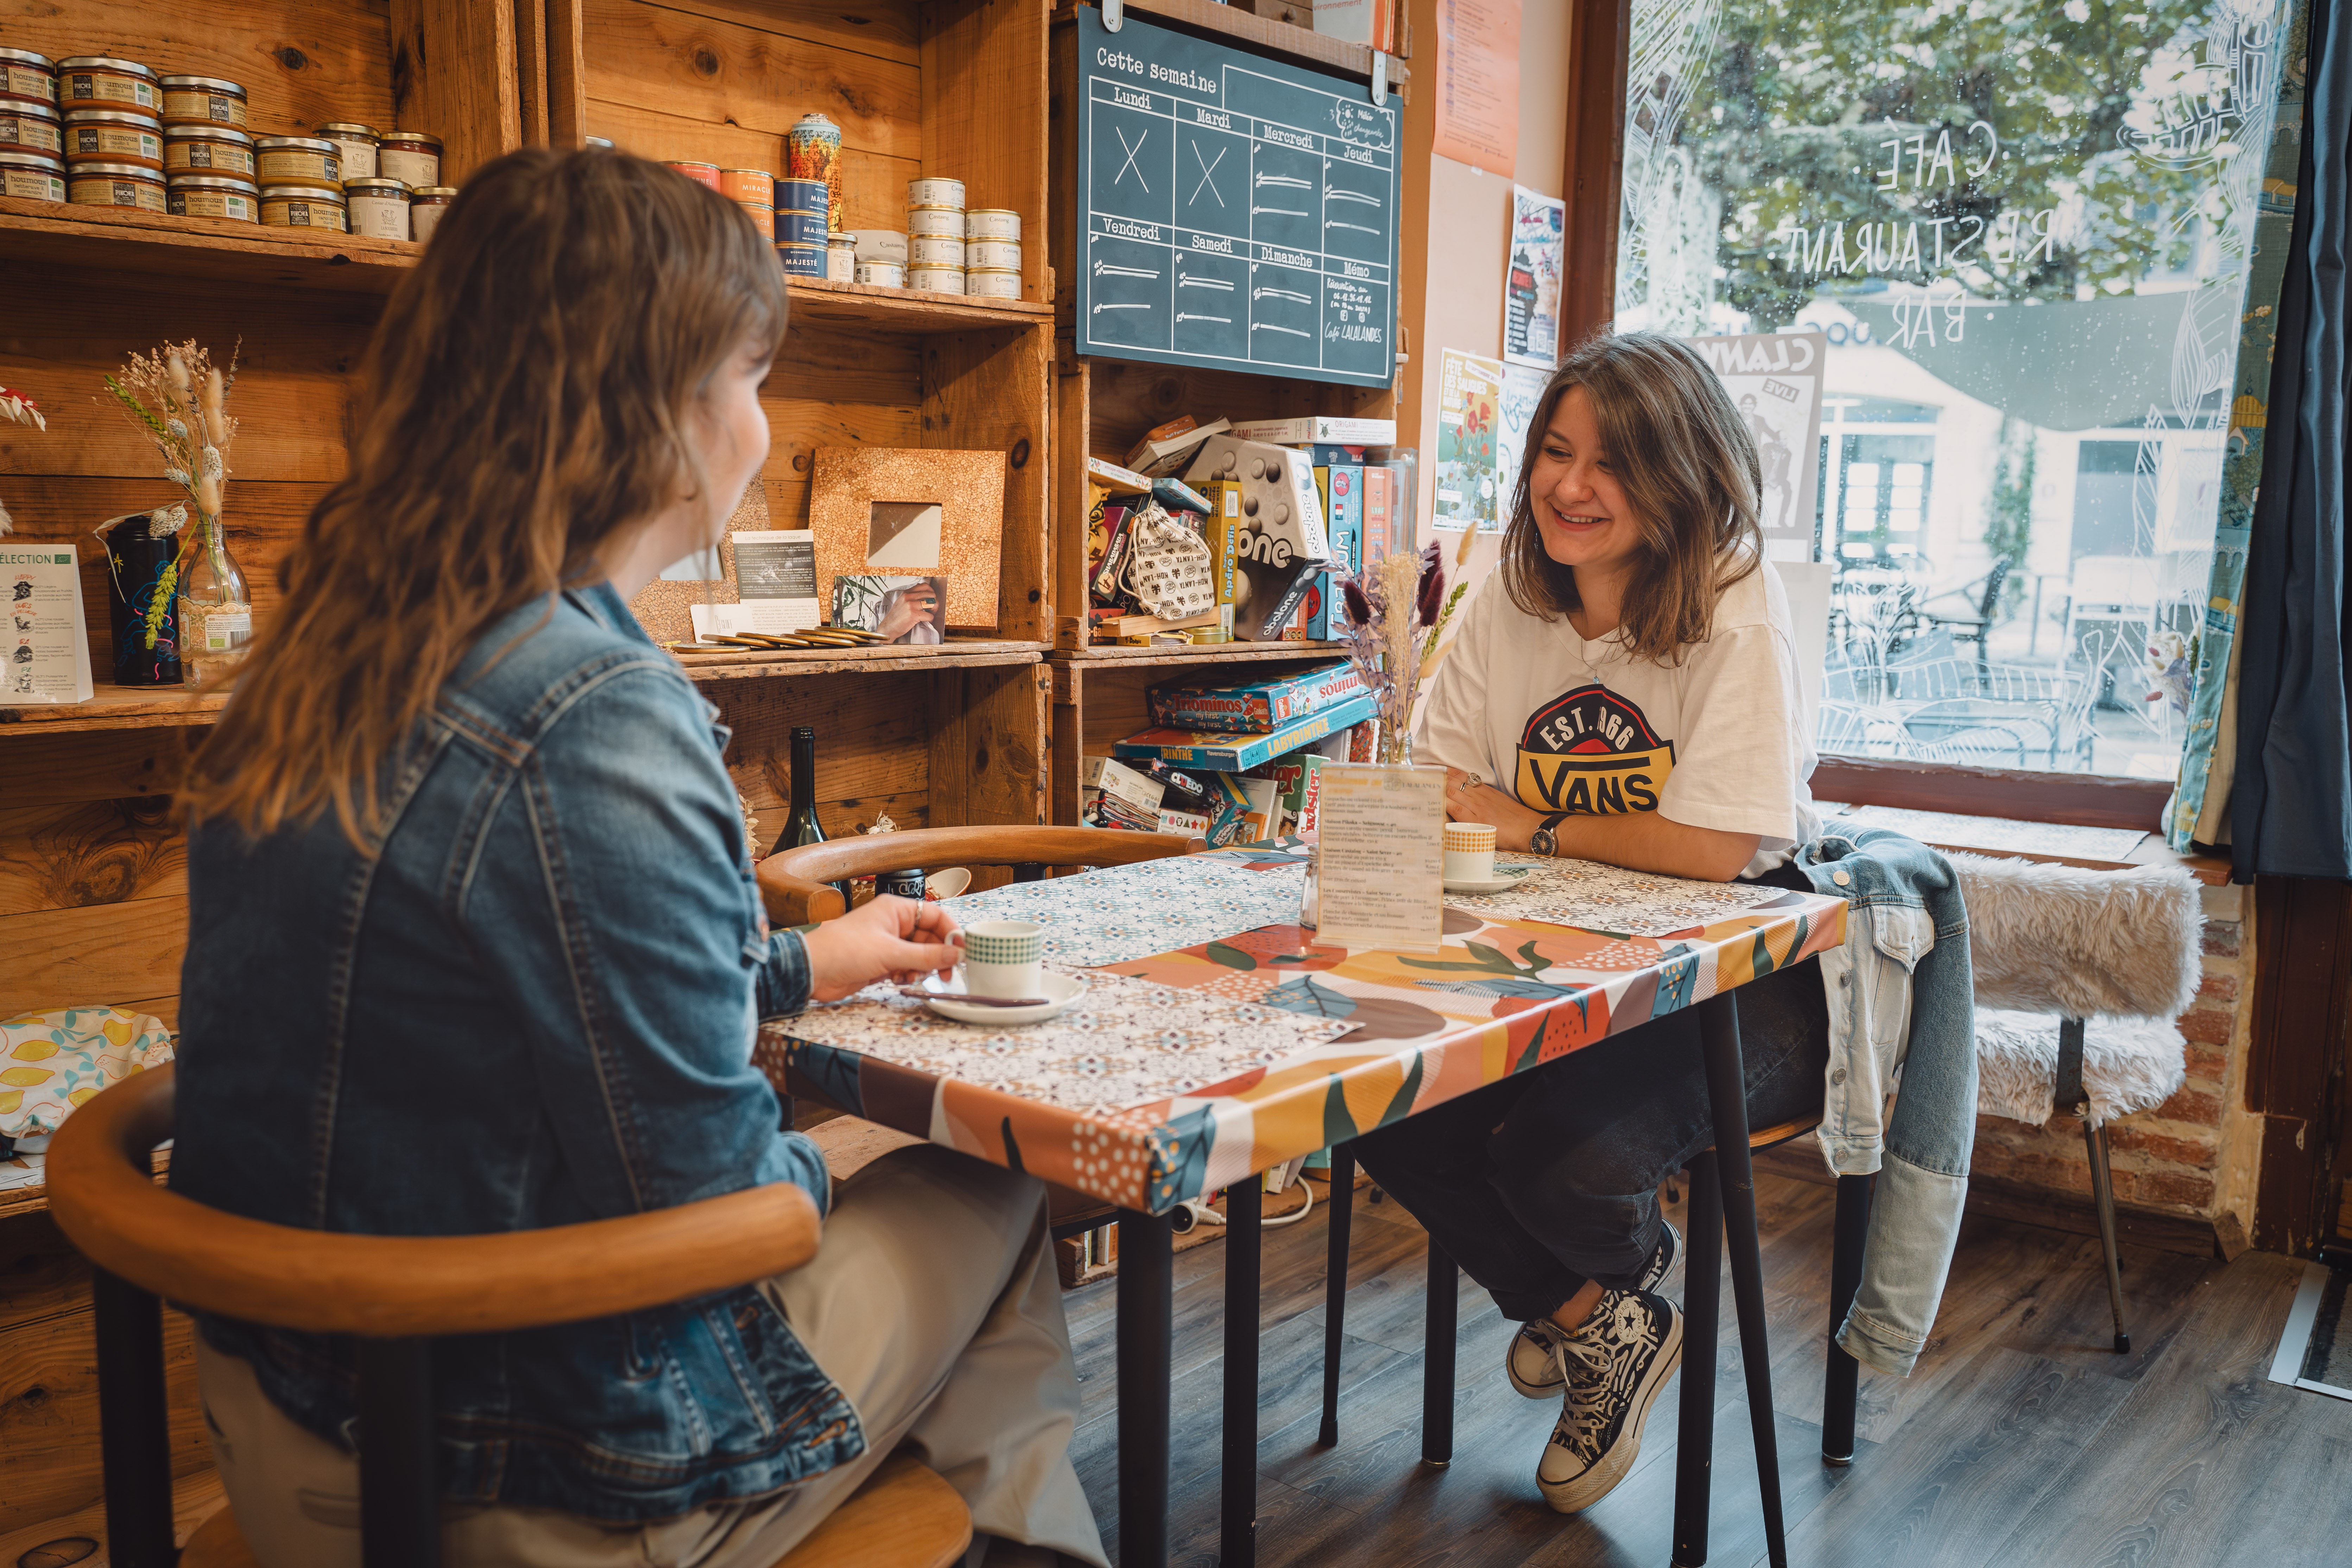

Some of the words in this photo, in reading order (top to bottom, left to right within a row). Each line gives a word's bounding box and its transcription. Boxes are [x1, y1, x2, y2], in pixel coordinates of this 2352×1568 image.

[1097, 47, 1144, 75] Cette
[1150, 62, 1217, 94] semaine
[13, 72, 45, 84] houmous
[96, 80, 132, 90] houmous
[1114, 87, 1152, 110] Lundi
[1196, 107, 1232, 129] Mardi
[23, 125, 53, 137] houmous
[102, 133, 138, 143] houmous
[356, 145, 372, 153] d'Aubergine
[1264, 125, 1314, 149] Mercredi
[1344, 145, 1374, 164] Jeudi
[215, 148, 245, 159] houmous
[11, 175, 46, 185] houmous
[742, 184, 771, 194] MIRACLE
[313, 208, 340, 217] houmous
[803, 226, 828, 236] MAJESTÉ
[941, 242, 959, 251] Castaing
[1003, 247, 1018, 255] Castaing
[1103, 218, 1161, 241] Vendredi
[1192, 235, 1233, 253] Samedi
[1262, 247, 1313, 268] Dimanche
[1344, 261, 1370, 278] Mémo
[785, 259, 817, 267] MAJESTÉ
[948, 273, 962, 282] Castaing
[1093, 303, 1103, 314] 19H
[1324, 321, 1340, 342] Café
[1341, 324, 1382, 343] LALALANDES
[1445, 356, 1463, 377] FÊTE
[1444, 374, 1457, 389] DES
[1335, 420, 1358, 428] ORIGAMI
[1302, 494, 1320, 554] abalone
[1103, 532, 1124, 575] SHABADABADA
[1176, 553, 1207, 563] KOH-LANTA
[1180, 578, 1208, 589] KOH-LANTA
[1263, 591, 1298, 637] abalone
[1171, 693, 1243, 713] Triominos
[1254, 707, 1268, 715] Goliath
[1277, 698, 1286, 719] Goliath
[1205, 712, 1219, 720] first
[1539, 706, 1594, 751] EST.
[1267, 717, 1330, 757] LABYRINTHE
[1171, 772, 1203, 794] CLUEDO
[1529, 755, 1659, 815] VANS
[1618, 1303, 1630, 1334] CONVERSE
